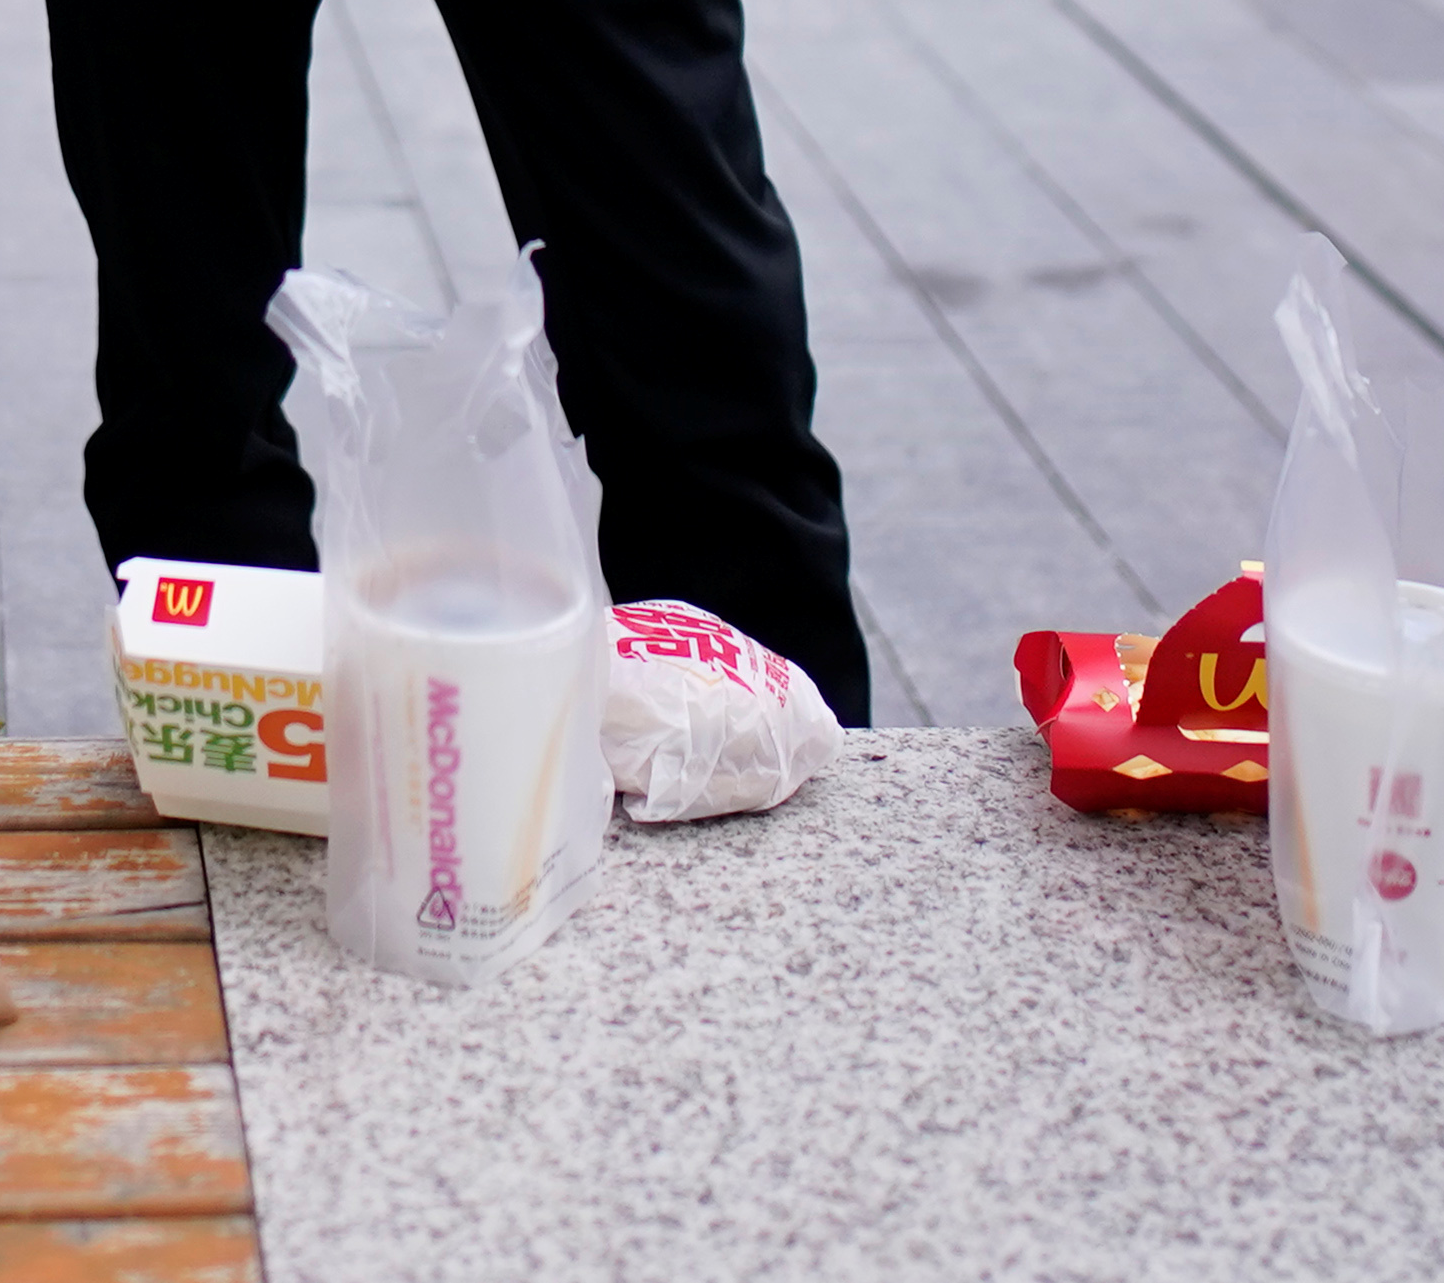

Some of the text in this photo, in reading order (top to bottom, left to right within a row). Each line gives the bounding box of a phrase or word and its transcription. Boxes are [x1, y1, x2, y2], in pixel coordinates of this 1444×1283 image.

[128, 690, 256, 730] Chick
[128, 708, 328, 783] 5 麦乐
